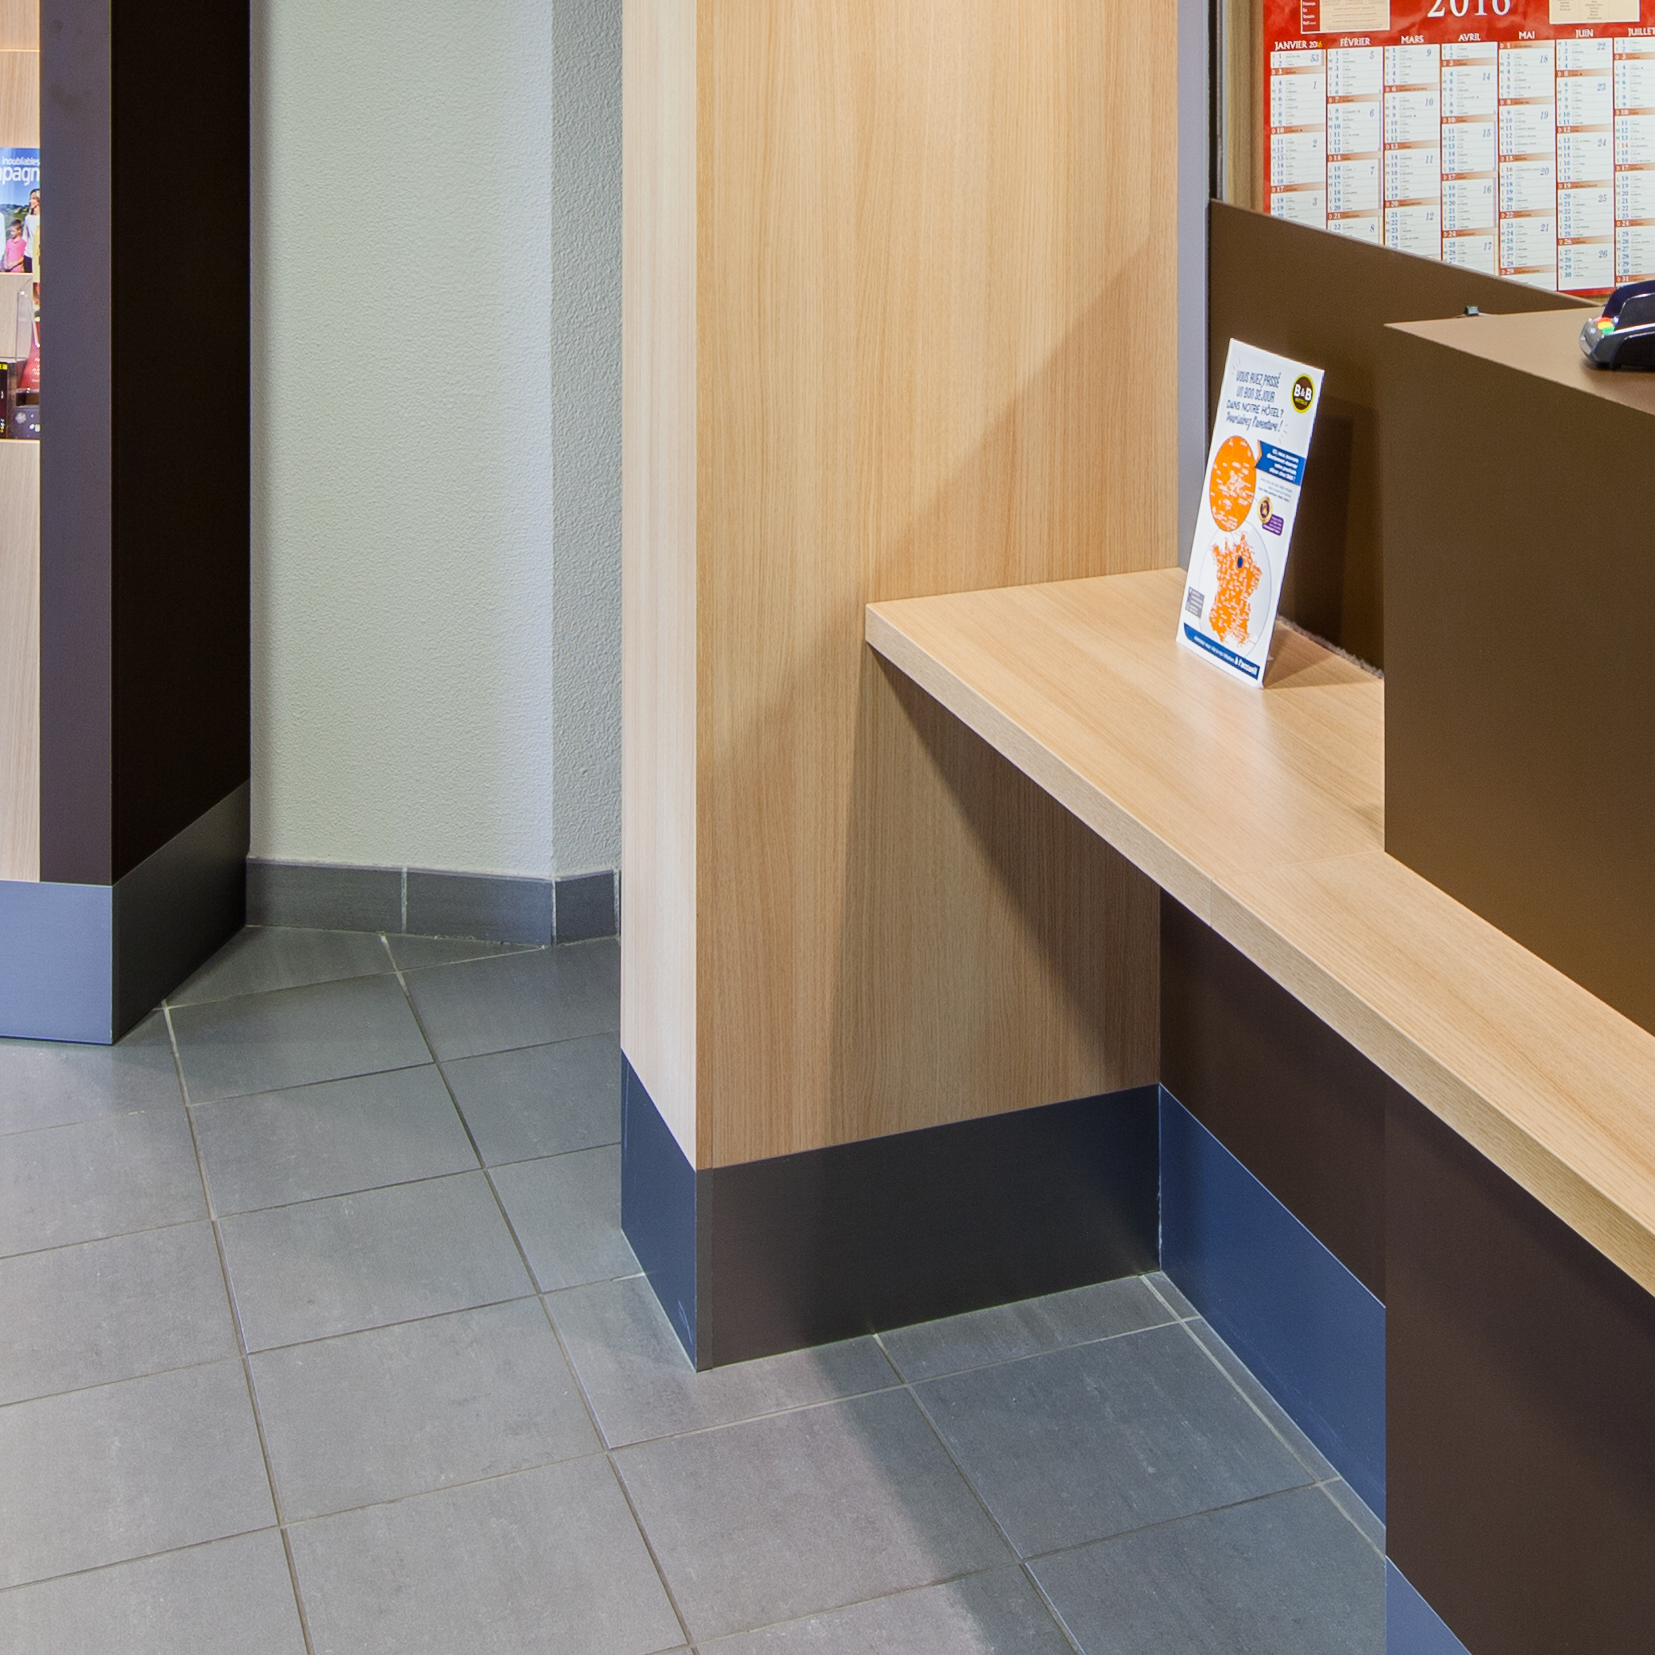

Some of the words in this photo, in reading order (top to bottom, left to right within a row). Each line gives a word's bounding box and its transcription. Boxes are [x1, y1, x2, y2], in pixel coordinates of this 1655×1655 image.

[1458, 32, 1481, 42] AVRIL
[1518, 30, 1536, 40] MAI
[1575, 28, 1594, 38] JUIN
[1339, 36, 1371, 47] FÉVRIER
[1400, 34, 1425, 44] MARS
[1274, 40, 1308, 52] JANVIER
[1236, 370, 1250, 383] VOUS
[1236, 385, 1244, 397] UN
[1243, 386, 1255, 399] BON
[1293, 383, 1312, 401] B&B
[1226, 399, 1241, 411] DANS
[1241, 402, 1260, 415] NOTRE
[1260, 404, 1279, 418] HÔTEL
